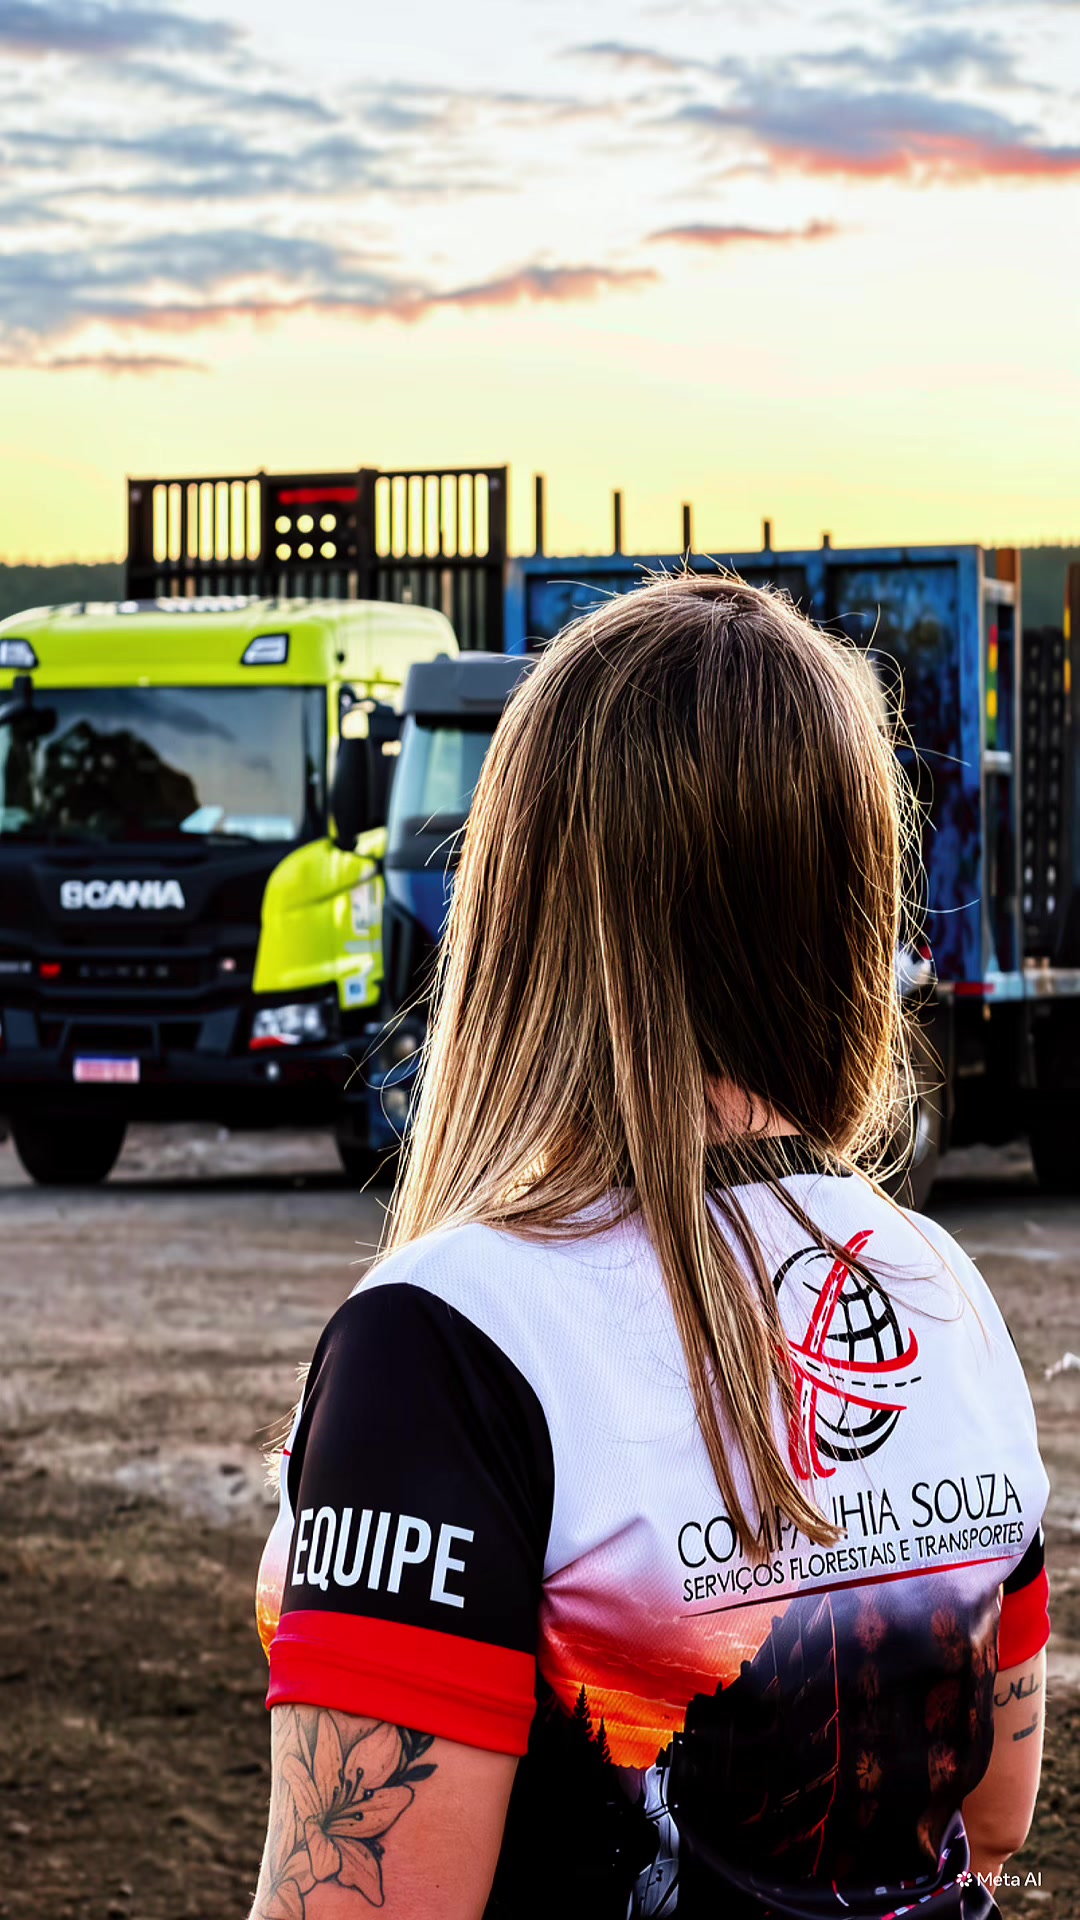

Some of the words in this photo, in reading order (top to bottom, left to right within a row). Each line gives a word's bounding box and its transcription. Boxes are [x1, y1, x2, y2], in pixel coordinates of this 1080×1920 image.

[60, 879, 186, 910] SCANIA
[911, 1473, 1022, 1528] SOUZA
[291, 1505, 475, 1609] EQUIPE
[683, 1561, 785, 1602] SERVIÇOS
[790, 1543, 896, 1581] FLORESTAIS
[900, 1539, 911, 1562] E
[915, 1521, 1024, 1555] TRANSPORTES
